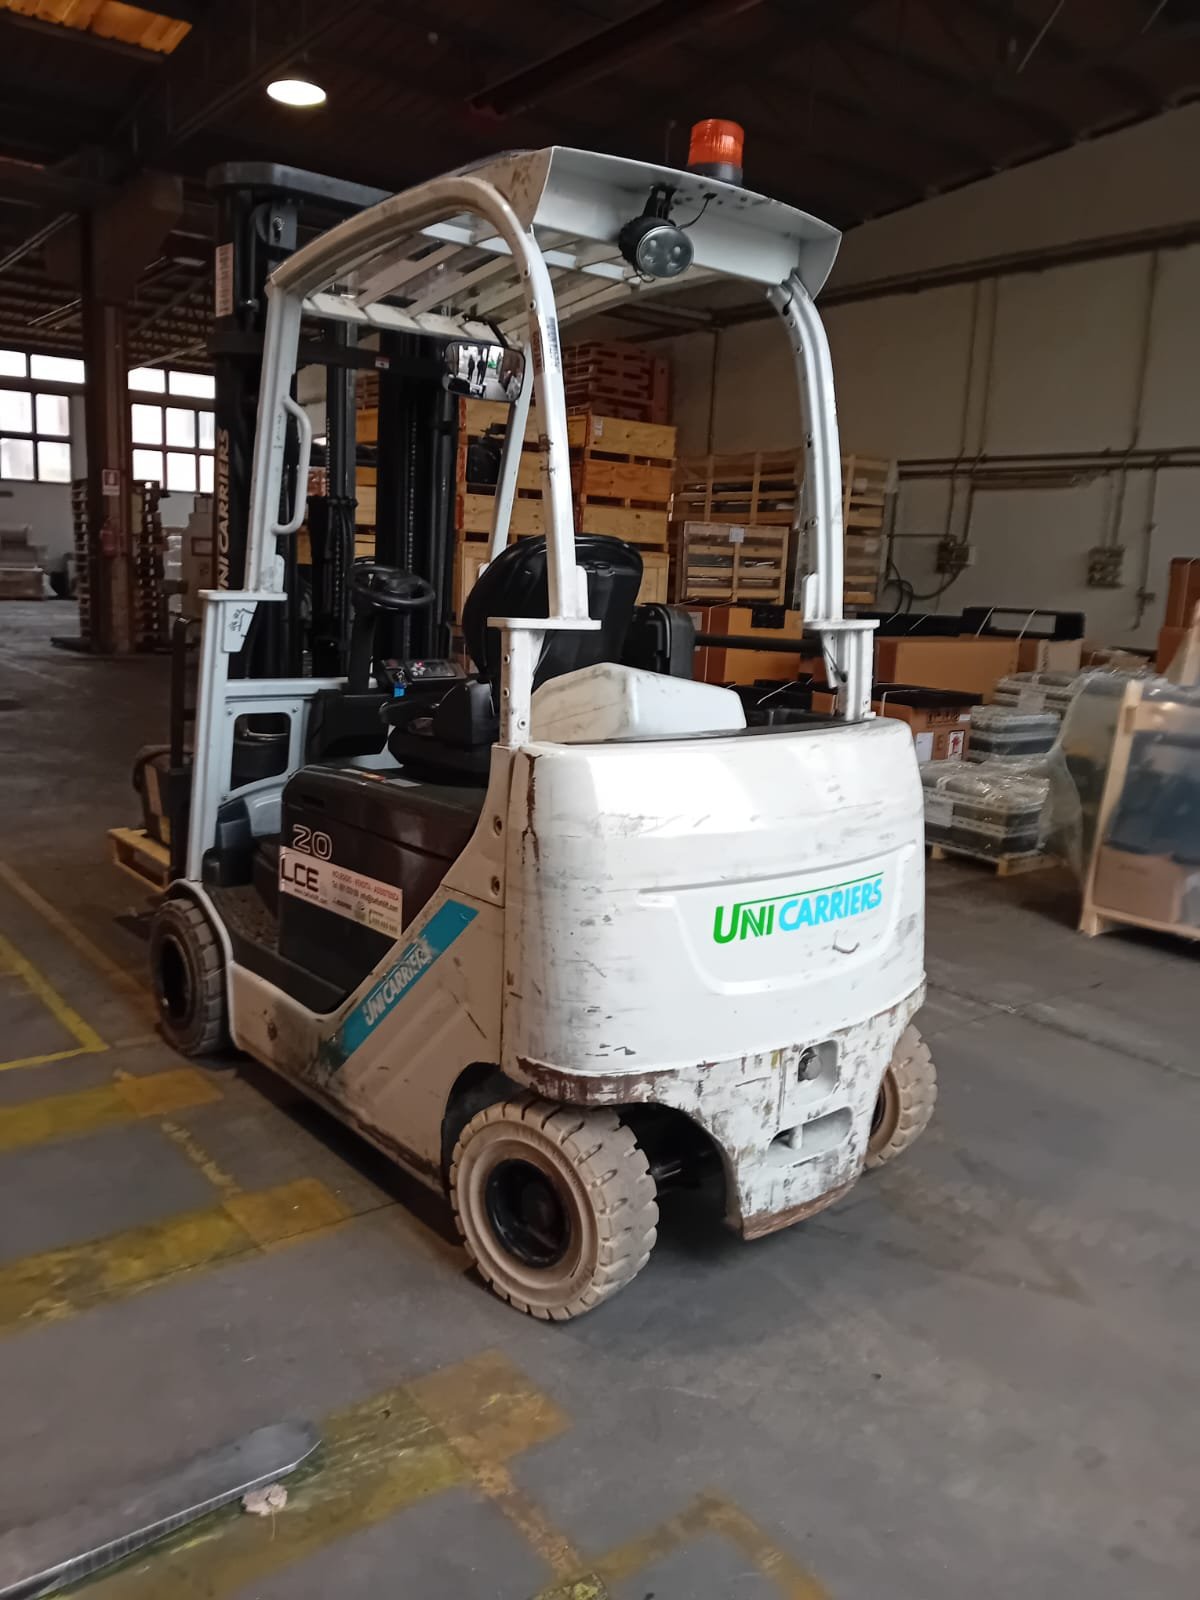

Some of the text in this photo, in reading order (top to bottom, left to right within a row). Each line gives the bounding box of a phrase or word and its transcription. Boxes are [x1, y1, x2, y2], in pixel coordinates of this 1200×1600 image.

[217, 427, 230, 592] NICARRIERS
[293, 823, 333, 861] 20
[281, 858, 320, 893] LCE
[713, 876, 883, 944] UNICARRIERS
